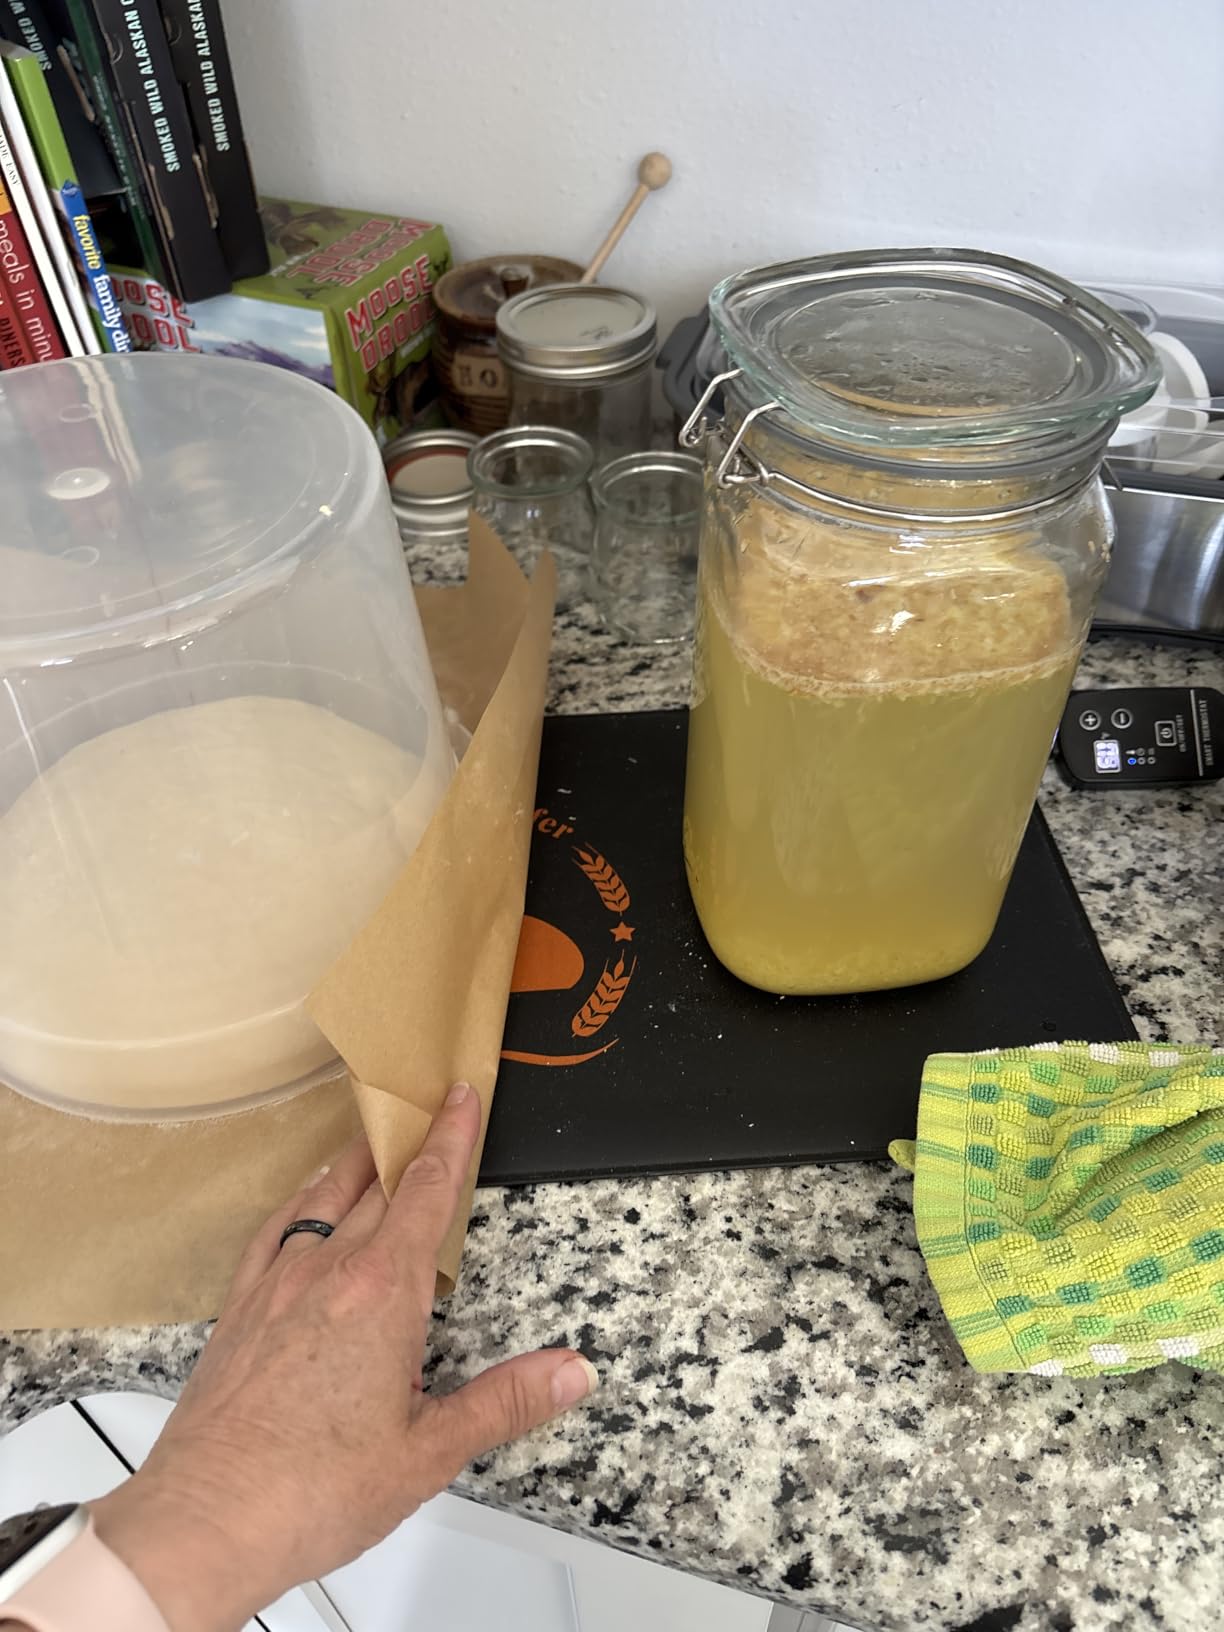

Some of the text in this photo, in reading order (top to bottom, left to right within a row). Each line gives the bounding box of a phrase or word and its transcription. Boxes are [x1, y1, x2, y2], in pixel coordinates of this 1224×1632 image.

[18, 17, 52, 70] SMOKED
[124, 10, 154, 75] ALASKAN
[144, 79, 164, 115] WILD
[200, 60, 219, 95] WILD
[154, 117, 181, 172] SMOKED
[208, 98, 230, 152] SMOKED
[0, 220, 30, 284] meals
[16, 289, 35, 310] in
[73, 214, 102, 270] favorite
[93, 274, 122, 329] family
[287, 219, 395, 279] DROOL
[313, 219, 437, 287] MOOSE
[344, 253, 433, 351] MOOSE
[124, 312, 200, 352] OOL
[1198, 699, 1212, 742] THERMOSTAT
